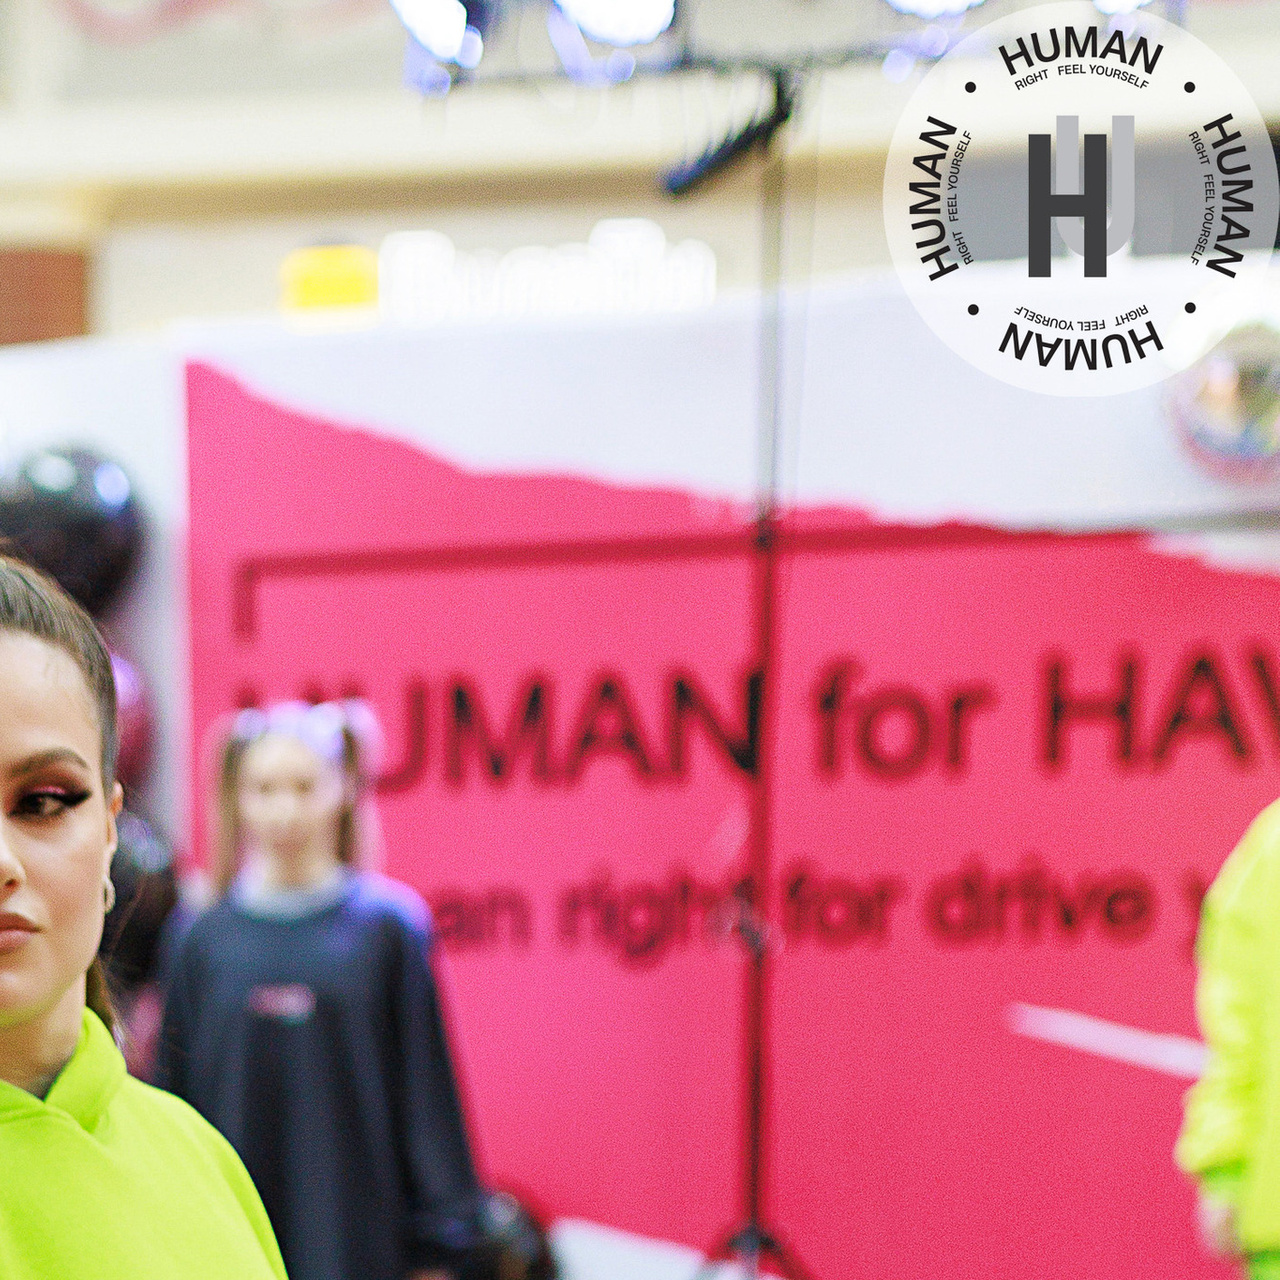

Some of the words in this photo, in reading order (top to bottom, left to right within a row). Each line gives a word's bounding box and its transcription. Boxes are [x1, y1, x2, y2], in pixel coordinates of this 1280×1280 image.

[233, 662, 766, 797] UMAN
[815, 654, 993, 782] for
[782, 860, 902, 946] for
[927, 856, 1157, 947] drive
